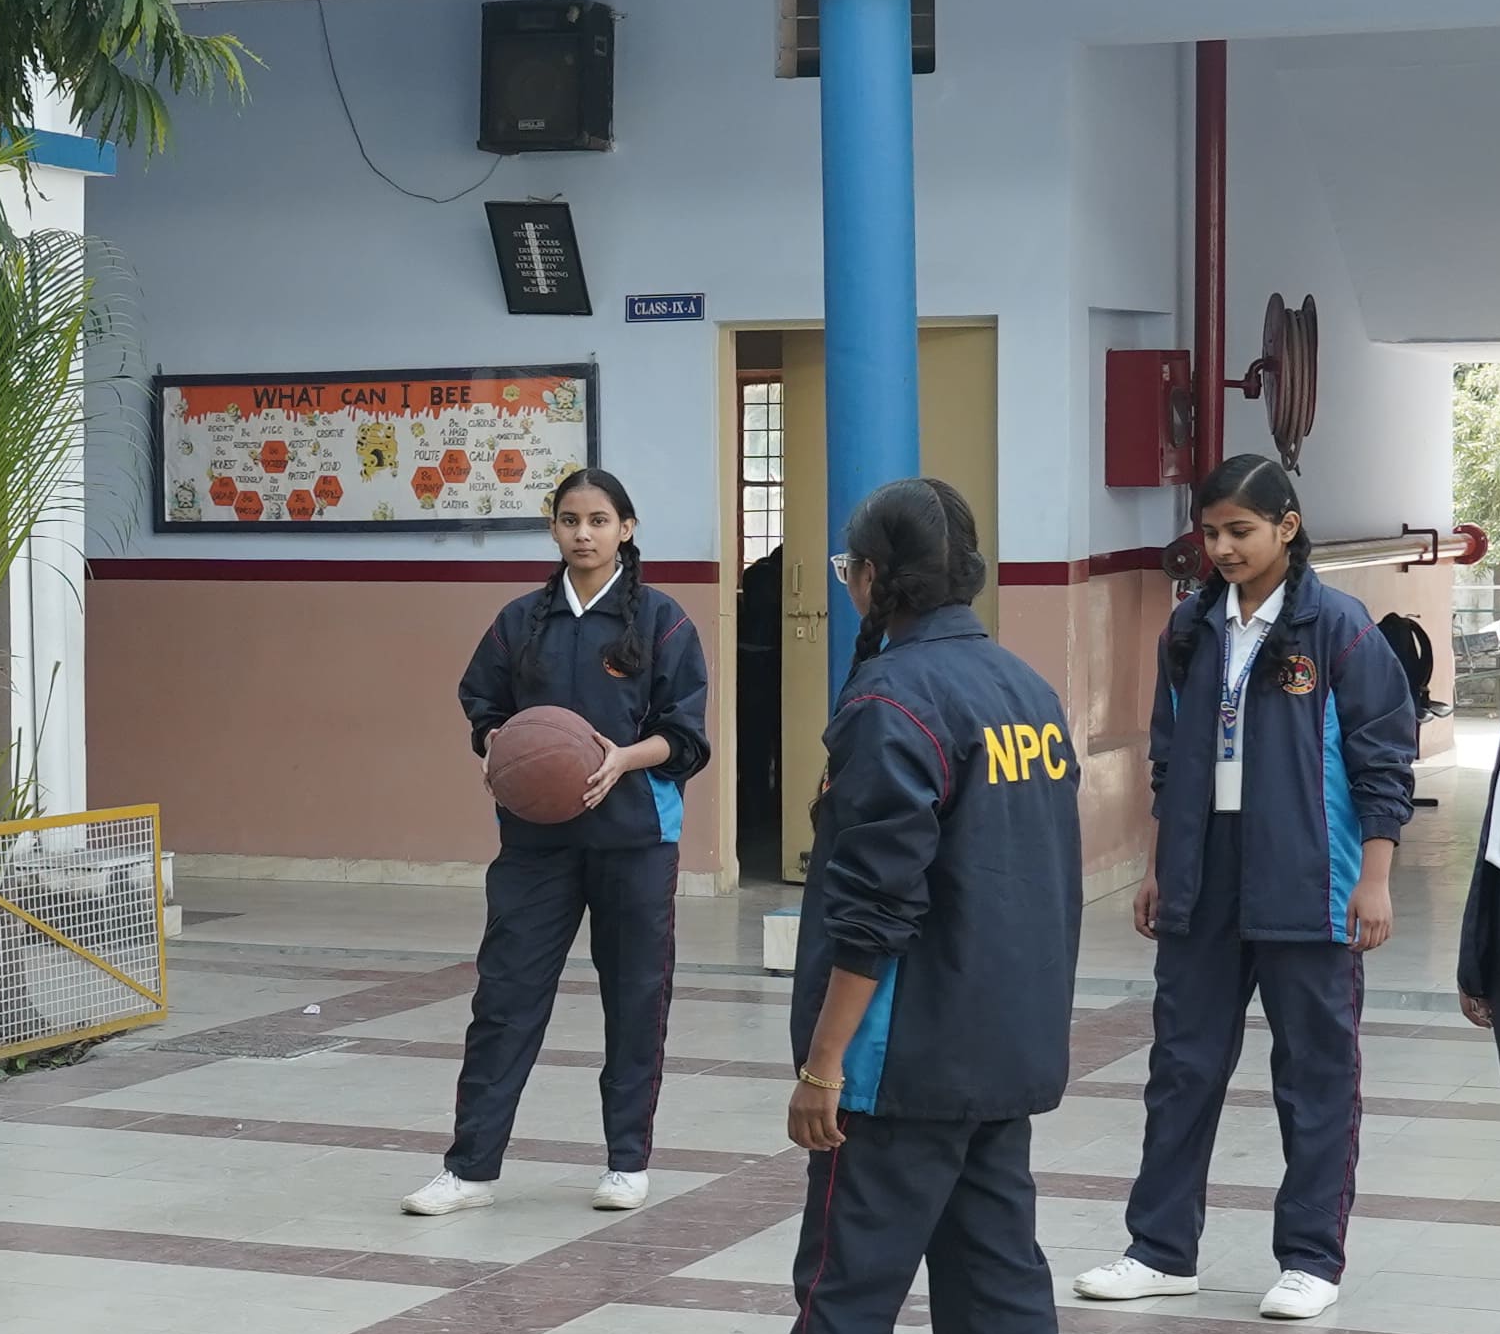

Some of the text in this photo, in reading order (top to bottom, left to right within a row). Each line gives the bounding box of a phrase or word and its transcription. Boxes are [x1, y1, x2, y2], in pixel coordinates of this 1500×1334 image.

[253, 384, 472, 408] WHAT CAN I BEE
[469, 450, 495, 462] CALM
[983, 723, 1067, 784] NPC
